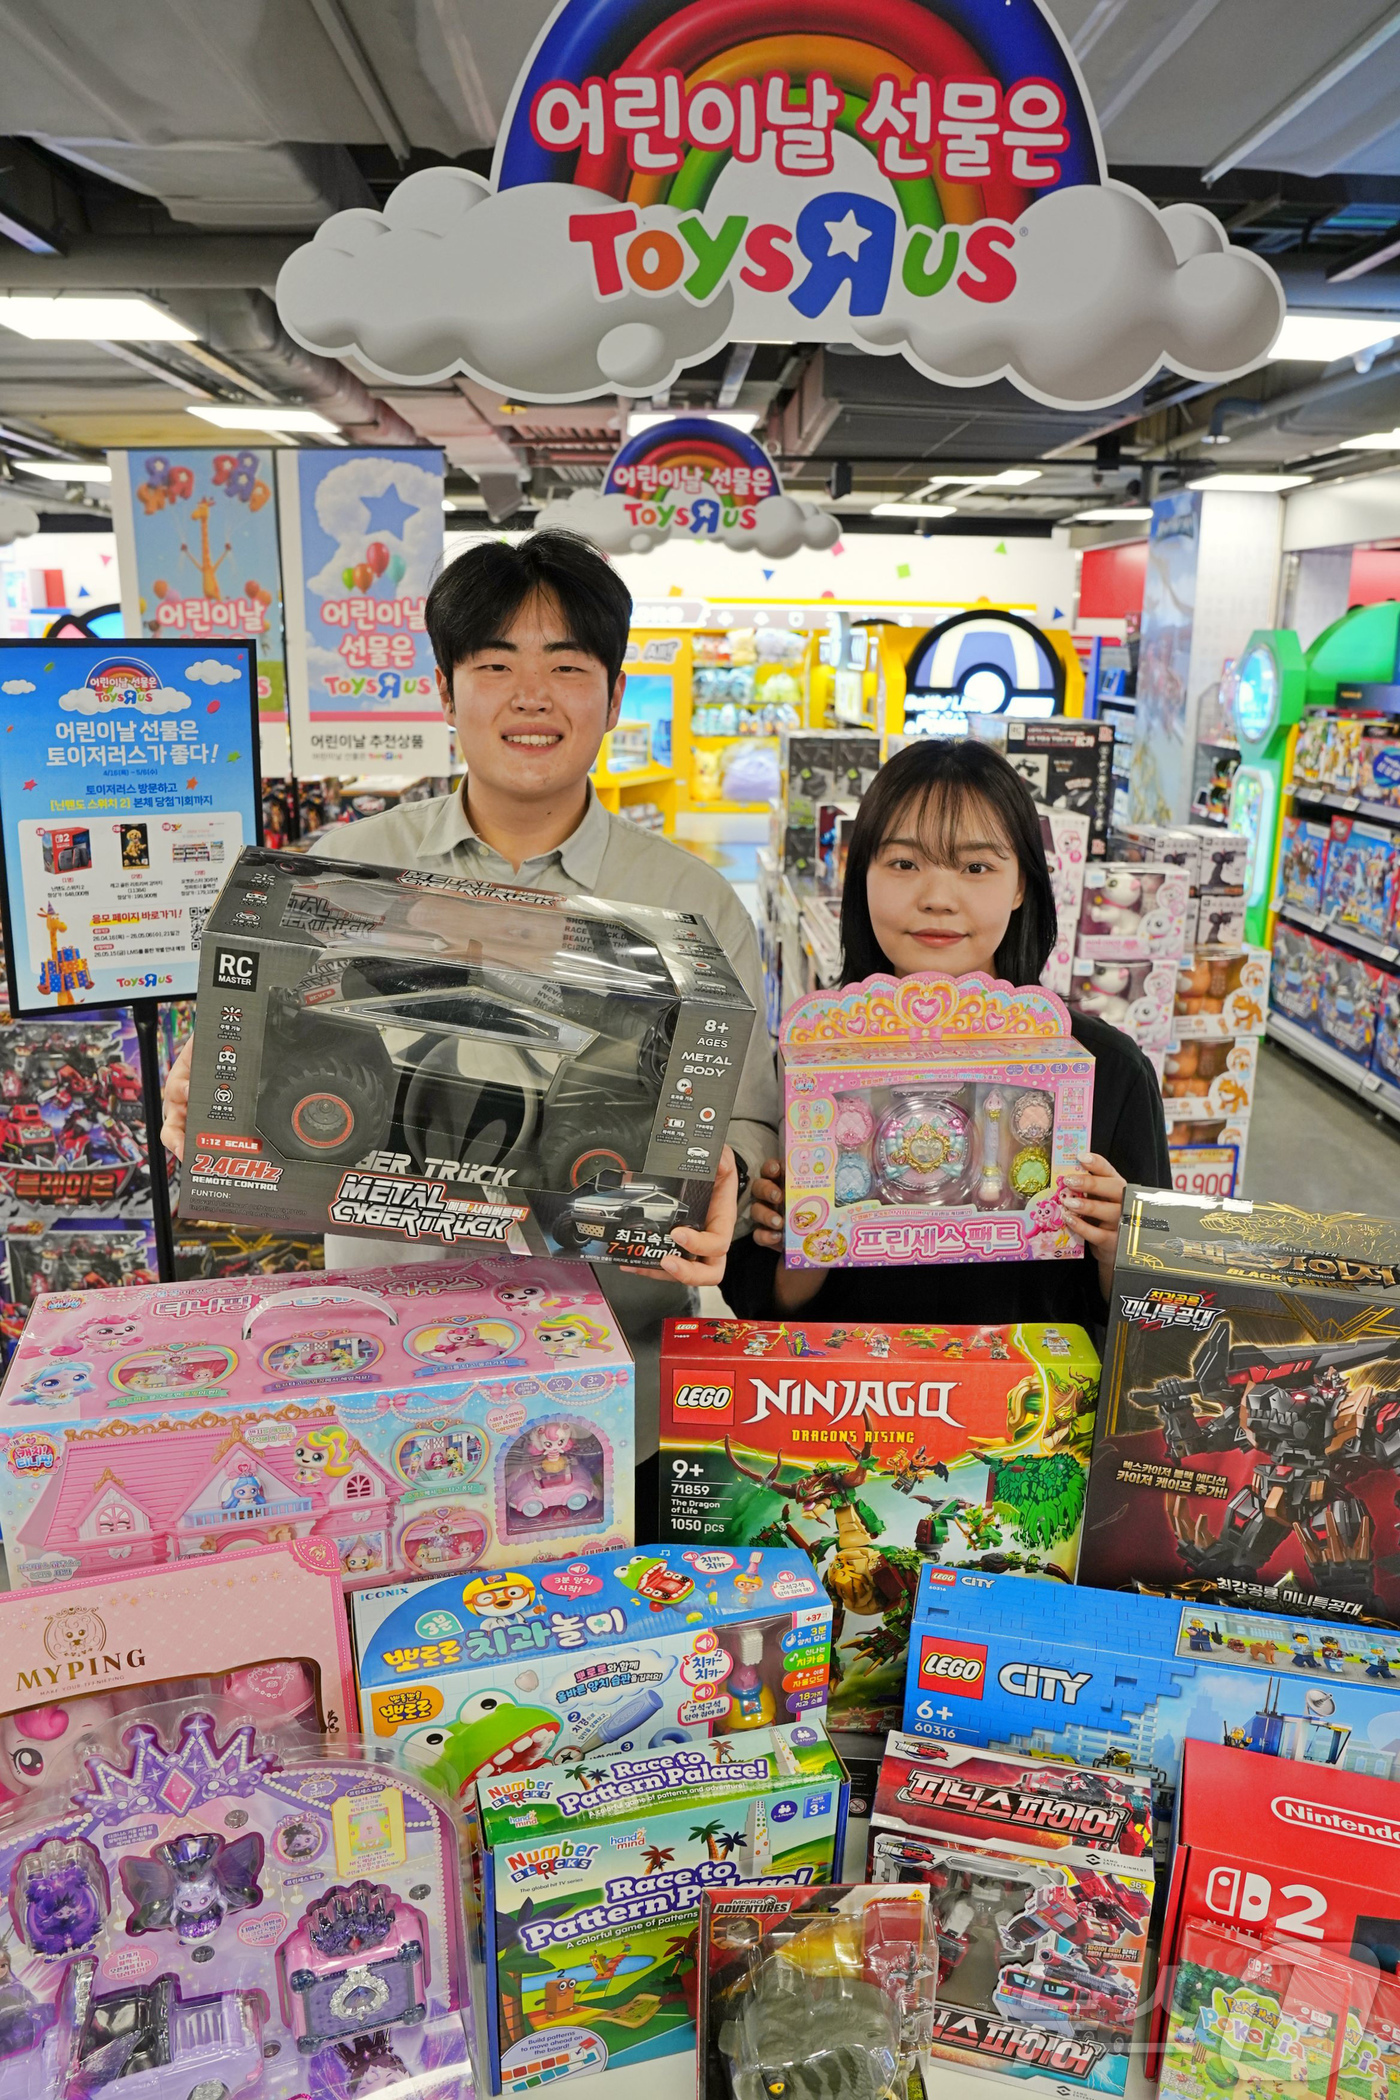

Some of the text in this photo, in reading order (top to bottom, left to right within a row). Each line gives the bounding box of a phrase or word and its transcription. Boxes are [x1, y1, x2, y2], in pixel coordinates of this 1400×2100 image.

[532, 71, 1069, 185] 어린이날 선물은
[613, 464, 772, 496] 어린이날 선물은
[156, 597, 264, 633] 어린이날
[340, 634, 414, 668] 선물은
[90, 677, 157, 688] 어린이날 선물은
[55, 720, 199, 743] 어린이날 선물은
[311, 734, 422, 749] 어린이날 추천상품
[46, 743, 219, 767] 토이저러스가 좋다!
[85, 783, 177, 796] 토이저러스 방문하고
[88, 799, 117, 809] 스위치
[120, 798, 131, 808] 2]
[133, 797, 153, 808] 본체
[155, 795, 213, 807] 당첨기회까지
[92, 909, 183, 924] 응모 페이지 바로가기!
[220, 953, 253, 977] RC
[218, 974, 252, 986] MASTER
[704, 1019, 729, 1033] 8+
[697, 1037, 728, 1048] AGES
[681, 1051, 732, 1065] METAL
[683, 1064, 726, 1077] BODY
[201, 1137, 258, 1150] 1:12 SCALE
[191, 1154, 284, 1183] 2.4GHz
[191, 1176, 279, 1192] REMOTE CONTROL
[340, 1173, 446, 1210] METAL
[191, 1189, 231, 1199] FUNTION:
[859, 1220, 1022, 1257] 프린세스 팩트
[1226, 1268, 1283, 1281] BLACK
[155, 1296, 252, 1317] 티니핑
[384, 1275, 482, 1299] 하우스
[1150, 1290, 1201, 1307] 최강공룡
[1124, 1300, 1220, 1329] 미니특공대
[676, 1323, 698, 1332] LEGO
[588, 1375, 598, 1384] 3+
[675, 1385, 733, 1410] LEGO
[741, 1378, 966, 1428] NINJAGO
[792, 1429, 914, 1443] DRAGONS RISING
[16, 1454, 53, 1469] 티니핑
[672, 1460, 704, 1478] 9+
[1116, 1469, 1230, 1501] 카이저 케이프 추가!!
[1173, 1467, 1195, 1481] 블랙
[1196, 1471, 1227, 1487] 에디션
[671, 1483, 710, 1495] 71859
[671, 1500, 720, 1511] The Dragon
[671, 1506, 699, 1516] of Life
[671, 1519, 725, 1535] 1050 pcs
[553, 1577, 594, 1588] 3분 양치
[931, 1573, 996, 1590] LEGO CITY
[361, 1587, 409, 1602] ICONIX
[559, 1585, 582, 1596] 시작!
[1217, 1576, 1364, 1618] 최강공룡 미니특공대
[422, 1616, 454, 1637] 3분
[811, 1625, 827, 1637] 3분
[384, 1645, 462, 1673] 뽀로로
[692, 1657, 722, 1668] 치카~
[16, 1649, 146, 1692] MYPING
[575, 1661, 640, 1683] 뽀로로와 함께
[695, 1668, 725, 1680] 치카~
[923, 1652, 1092, 1705] LEGO CITY
[556, 1684, 587, 1704] 올바른
[587, 1678, 611, 1693] 양치
[380, 1700, 432, 1722] 뽀로로
[690, 1701, 721, 1712] 구석구석
[916, 1701, 953, 1722] 6+
[914, 1722, 957, 1740] 60316
[612, 1751, 704, 1780] Race to
[313, 1782, 326, 1795] 3+
[486, 1778, 553, 1801] Number
[558, 1758, 770, 1816] Pattern Palace!
[657, 1789, 688, 1801] patterns
[492, 1789, 550, 1808] BLOCKS
[808, 1804, 826, 1815] 3+
[515, 1818, 538, 1828] mind
[617, 1836, 646, 1849] mind
[507, 1839, 600, 1869] Number
[511, 1857, 597, 1882] BLOCKS
[533, 1884, 549, 1892] global
[565, 1878, 584, 1886] series
[608, 1868, 688, 1903] Race
[694, 1861, 736, 1884] to
[1130, 1881, 1147, 1890] 36+
[716, 1903, 788, 1914] ADVENTURES
[1276, 1883, 1328, 1939] 2
[523, 1892, 675, 1950] Pattern
[576, 1930, 614, 1947] colorful
[615, 1922, 644, 1938] game
[646, 1918, 657, 1928] of
[660, 1911, 698, 1927] patterns
[556, 1968, 566, 1978] 2
[528, 2031, 576, 2046] Build patterns
[529, 2042, 546, 2051] move
[548, 2038, 568, 2047] ahead
[533, 2043, 570, 2056] the board!
